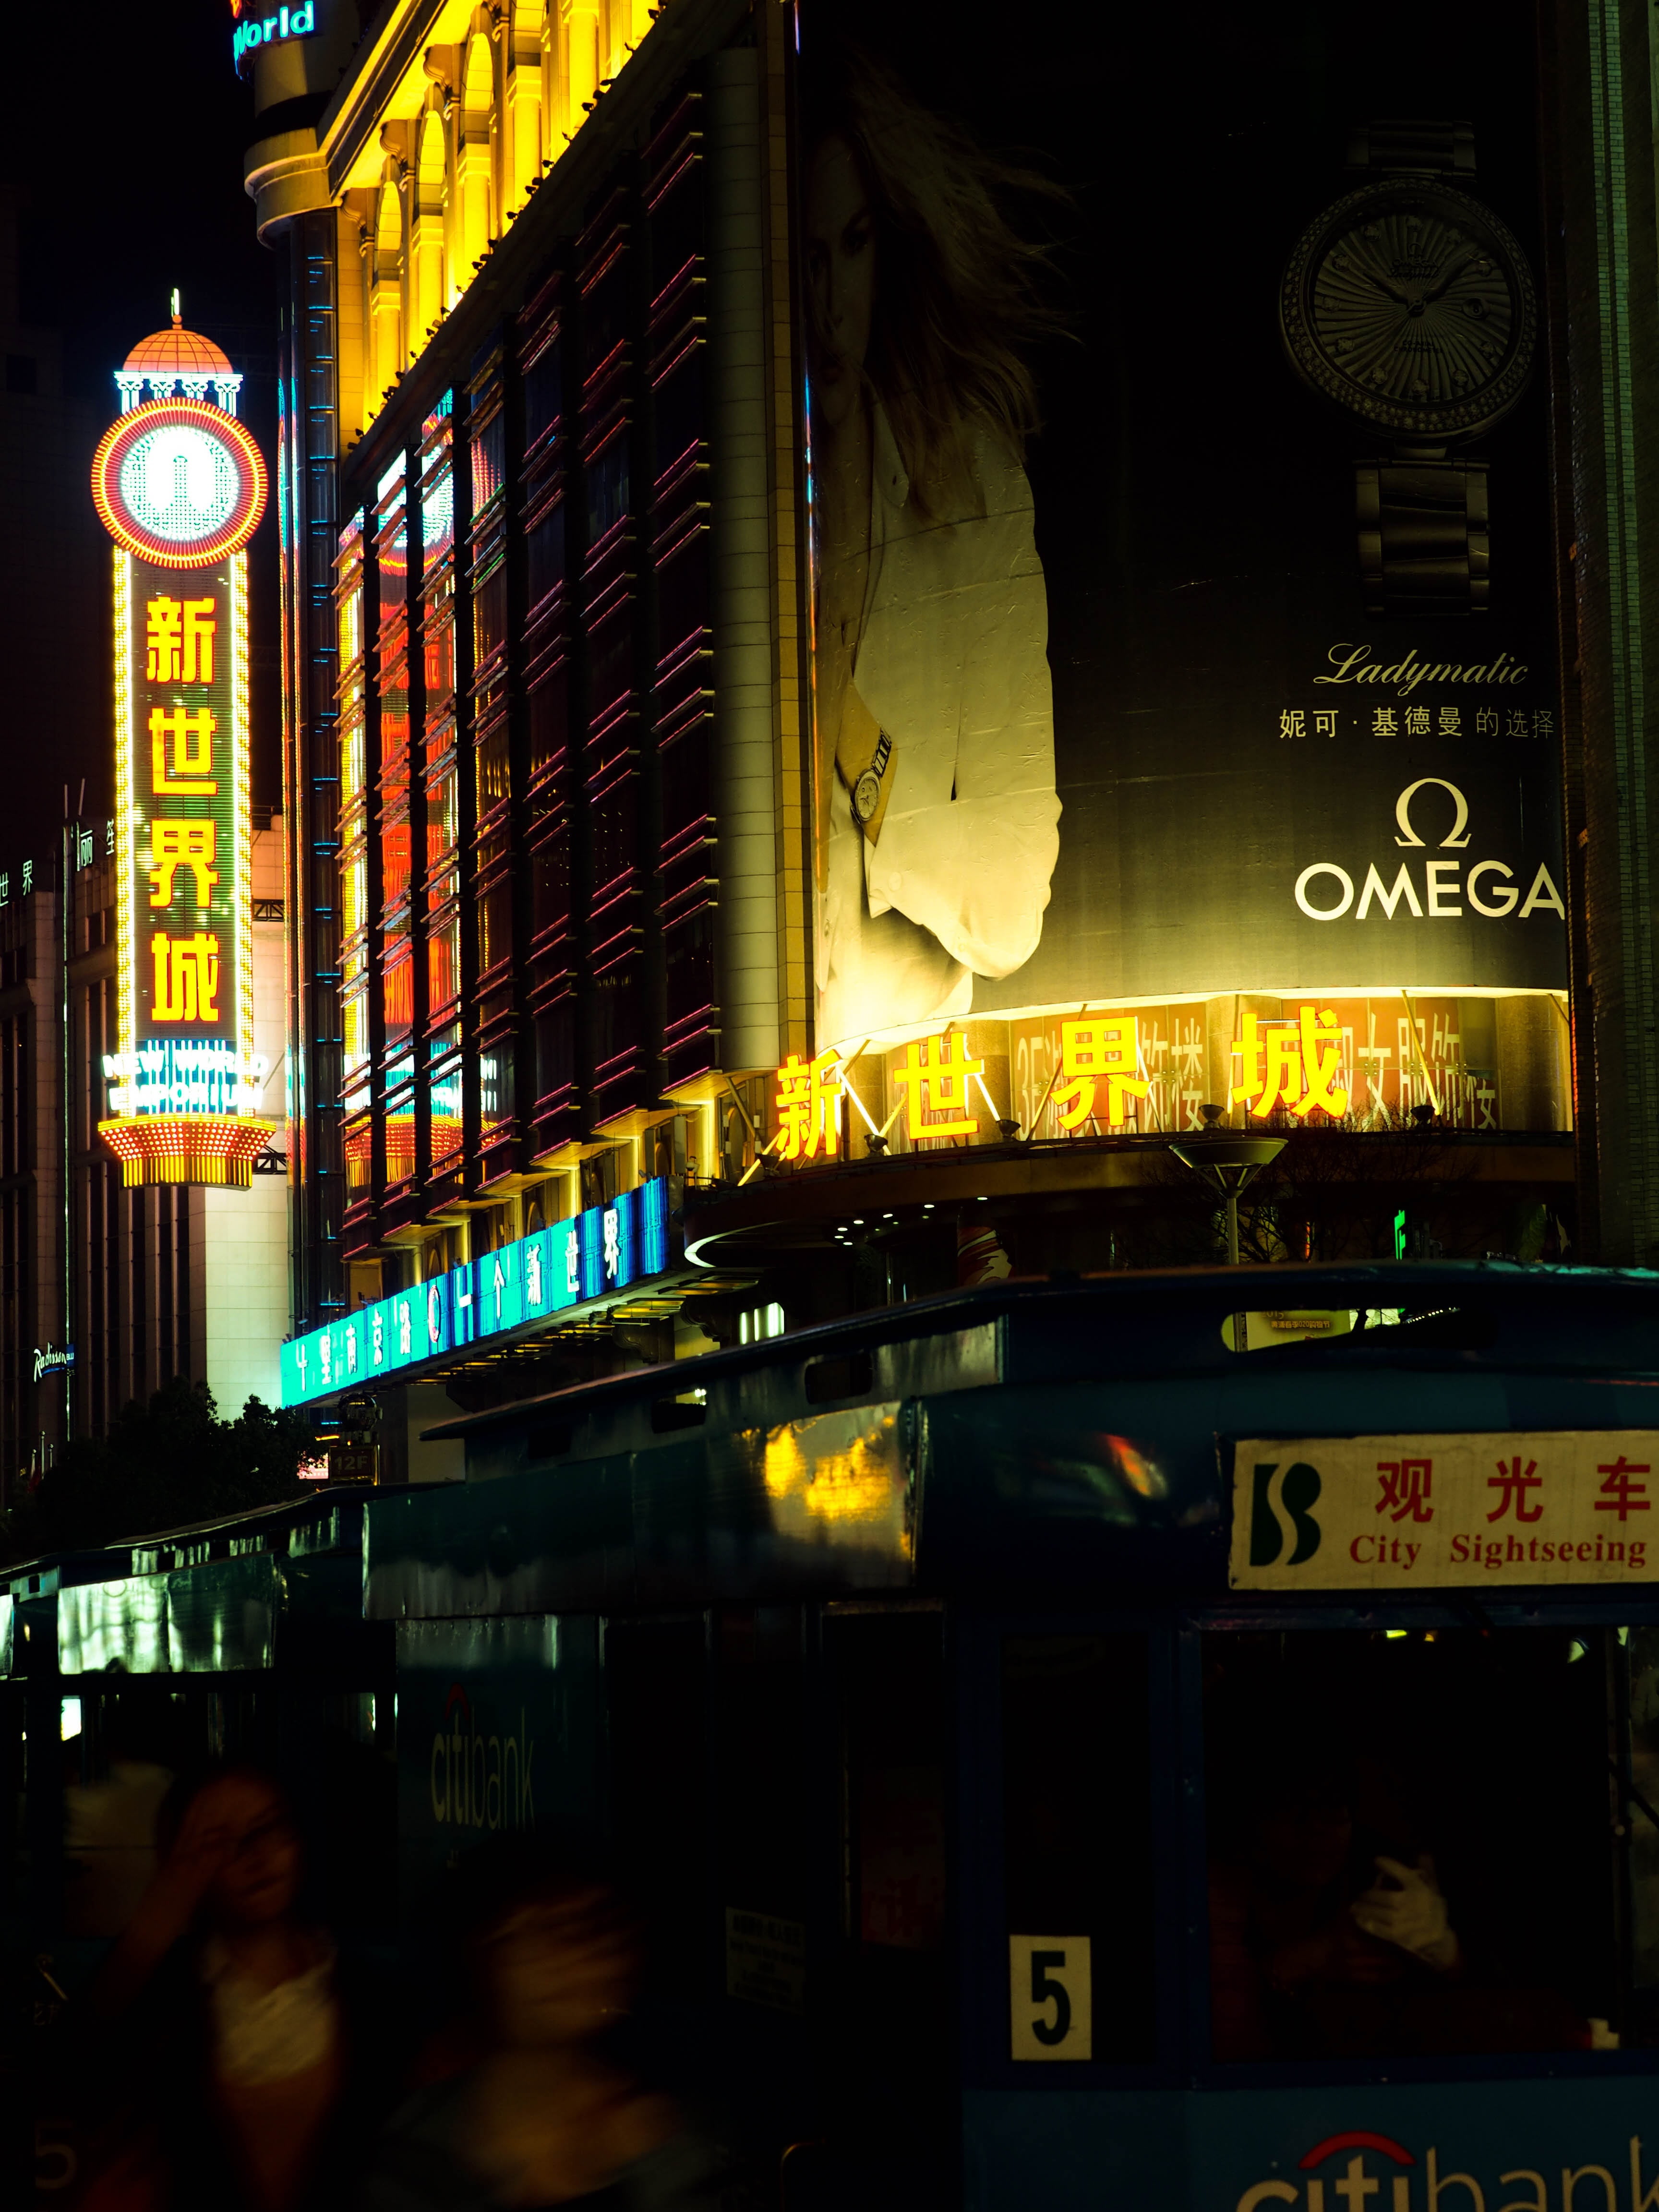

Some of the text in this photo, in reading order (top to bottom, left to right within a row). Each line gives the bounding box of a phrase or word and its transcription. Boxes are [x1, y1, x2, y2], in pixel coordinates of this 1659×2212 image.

[233, 0, 314, 61] World
[1313, 643, 1528, 697] Ladymatic
[146, 596, 220, 1022] 新世界城
[1295, 860, 1565, 920] OMEGA
[102, 1048, 270, 1078] NEW WORLD
[775, 1006, 1348, 1161] 新世界城
[108, 1082, 264, 1111] EMPORIUM
[34, 1342, 67, 1383] Radisson
[1375, 1456, 1650, 1523] 观光车
[1349, 1534, 1647, 1570] City Sightseeing
[1031, 1951, 1070, 2045] 5
